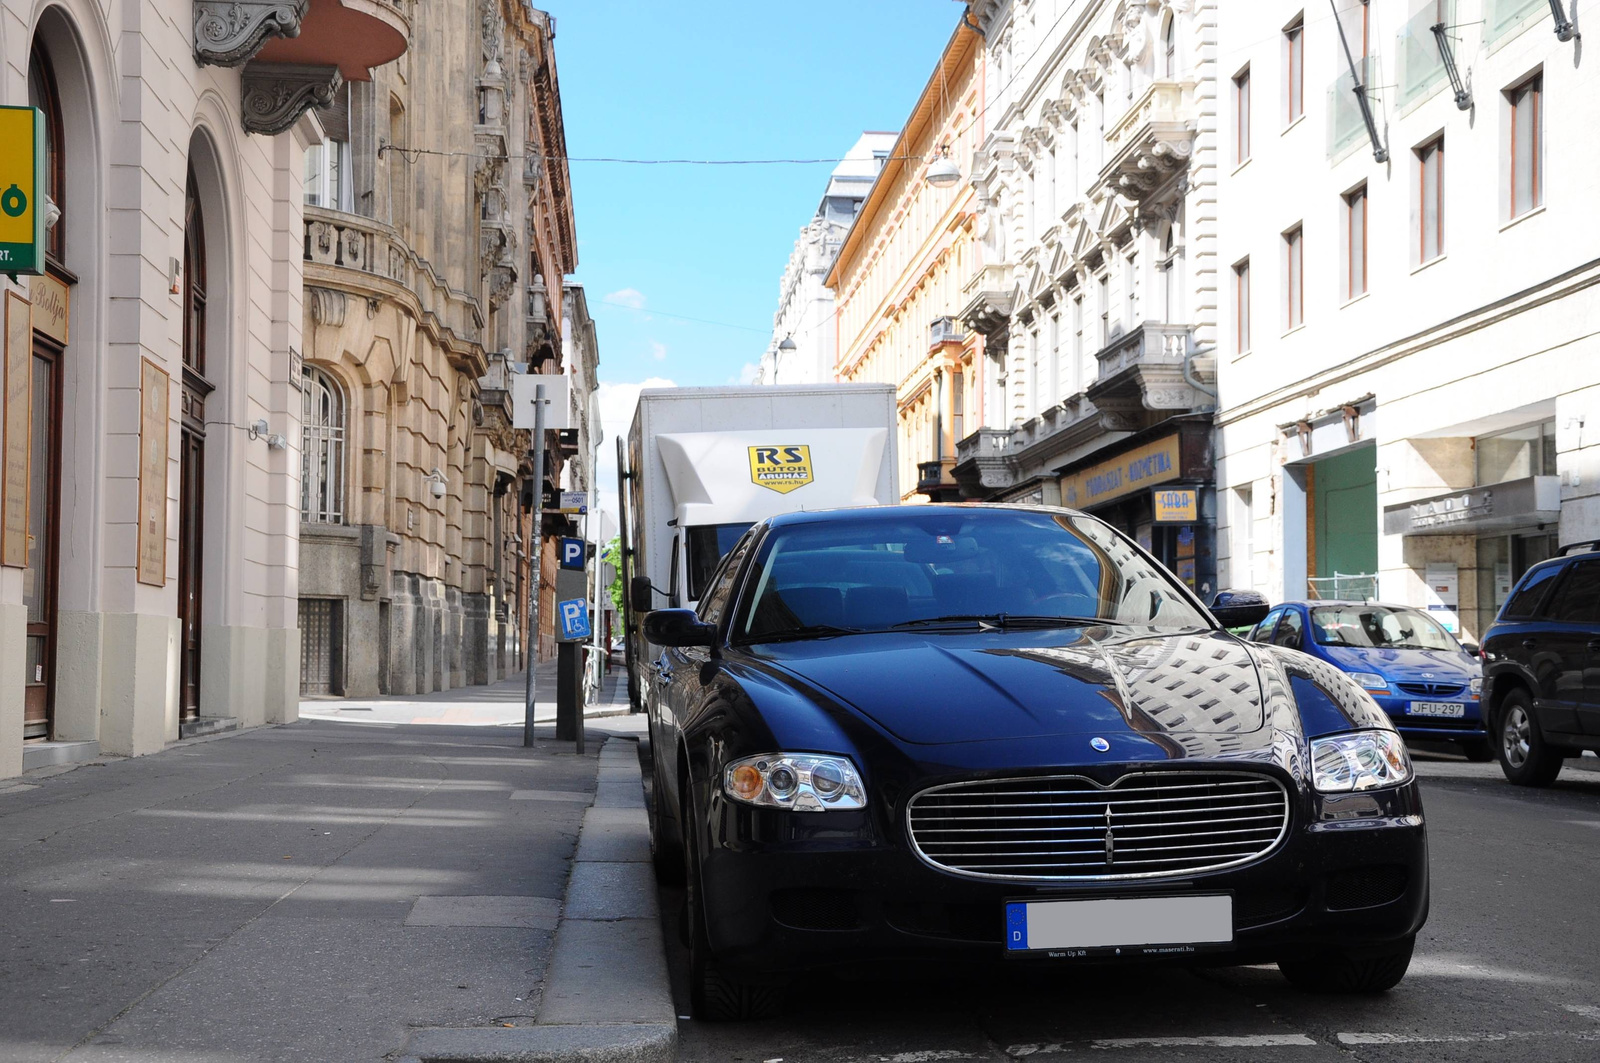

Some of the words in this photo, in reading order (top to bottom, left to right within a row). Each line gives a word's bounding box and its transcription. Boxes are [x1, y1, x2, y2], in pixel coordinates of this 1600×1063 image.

[36, 282, 65, 326] Boltja
[756, 447, 803, 466] RS
[565, 543, 581, 563] P
[563, 603, 581, 633] P
[1413, 703, 1462, 714] JFU-297
[1013, 931, 1021, 941] D
